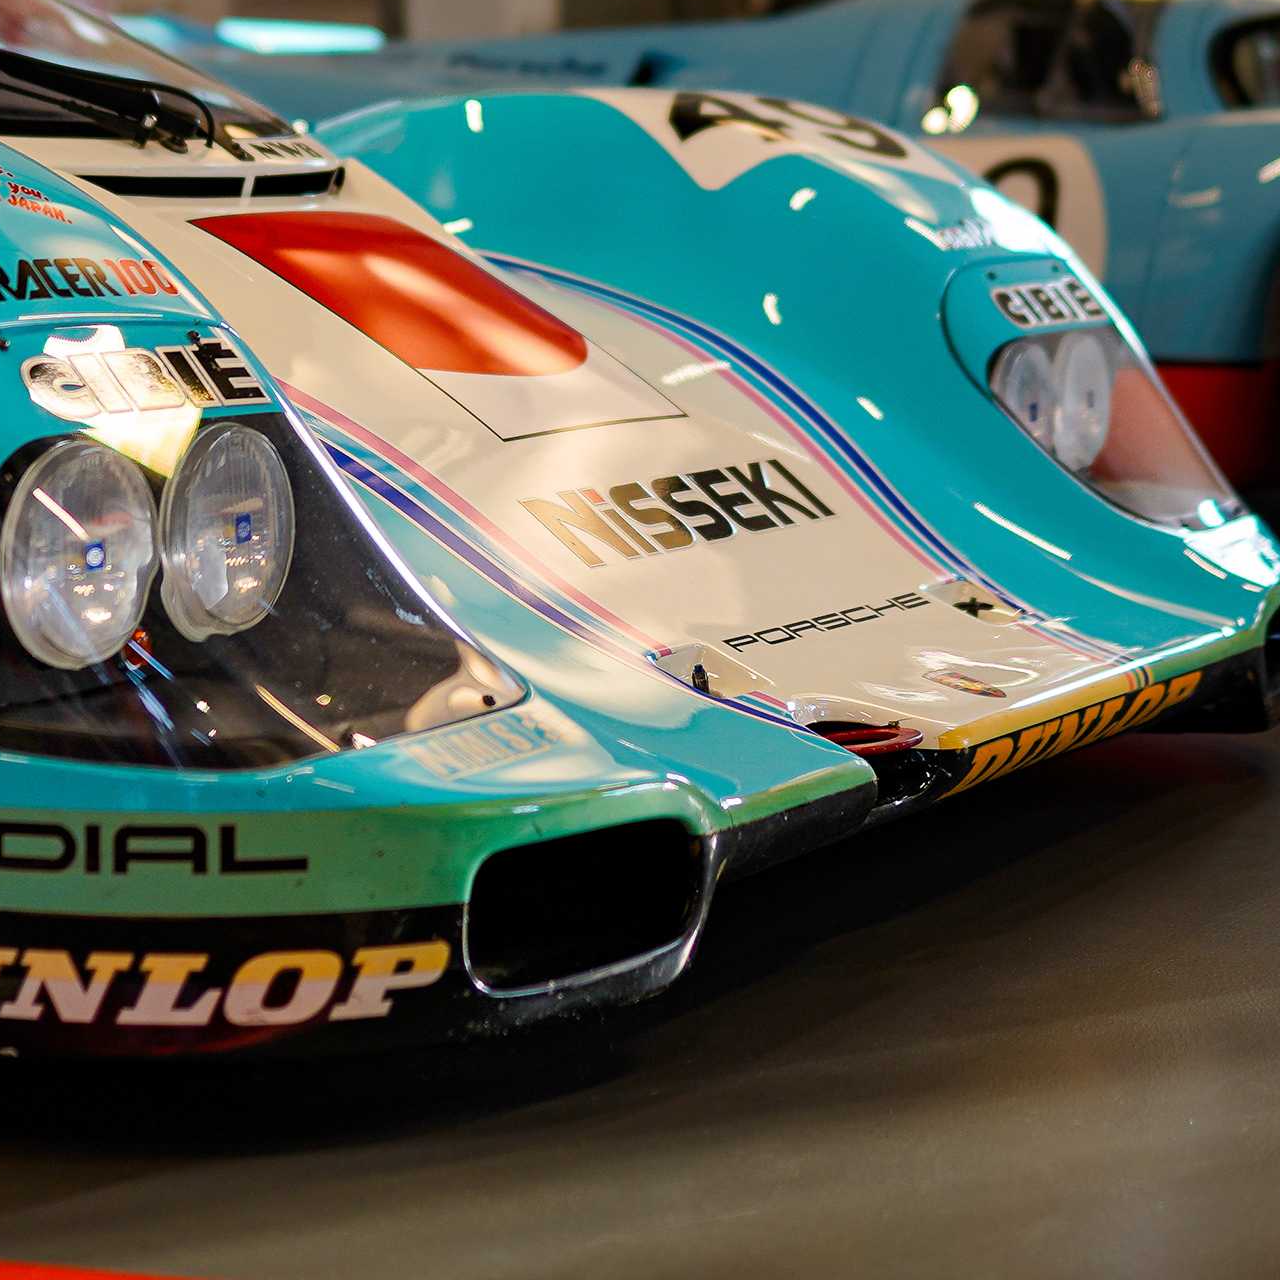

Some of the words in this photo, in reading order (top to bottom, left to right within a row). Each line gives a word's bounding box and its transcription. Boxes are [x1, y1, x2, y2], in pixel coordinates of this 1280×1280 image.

[7, 195, 74, 225] JAPAN.
[8, 182, 50, 202] you.
[102, 258, 182, 298] 100
[722, 592, 931, 654] PORSCHE
[935, 671, 1203, 802] DUNLOP
